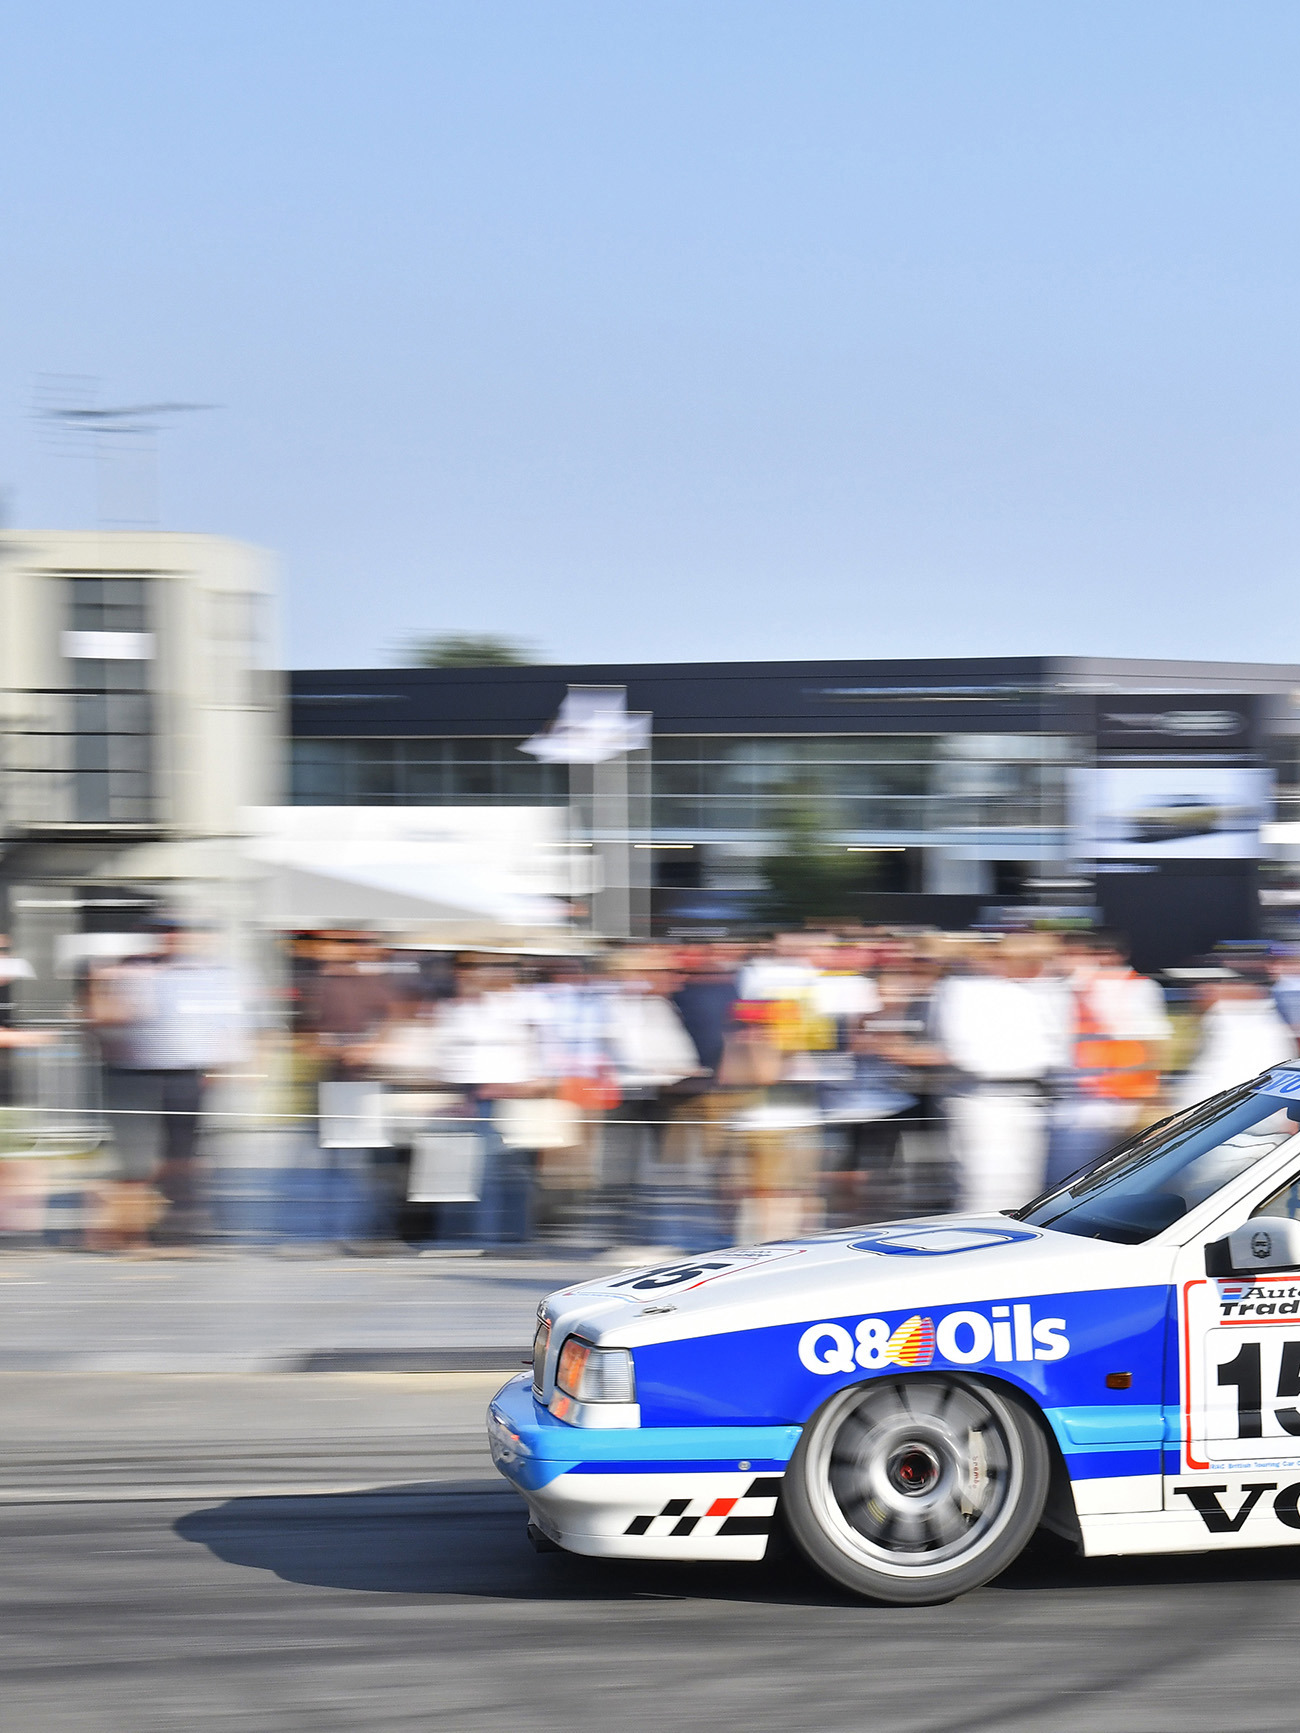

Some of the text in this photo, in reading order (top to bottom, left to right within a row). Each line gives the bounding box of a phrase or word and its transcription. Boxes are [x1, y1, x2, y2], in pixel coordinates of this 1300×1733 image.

[606, 1262, 735, 1290] 15
[798, 1303, 1070, 1375] Q8 Oils
